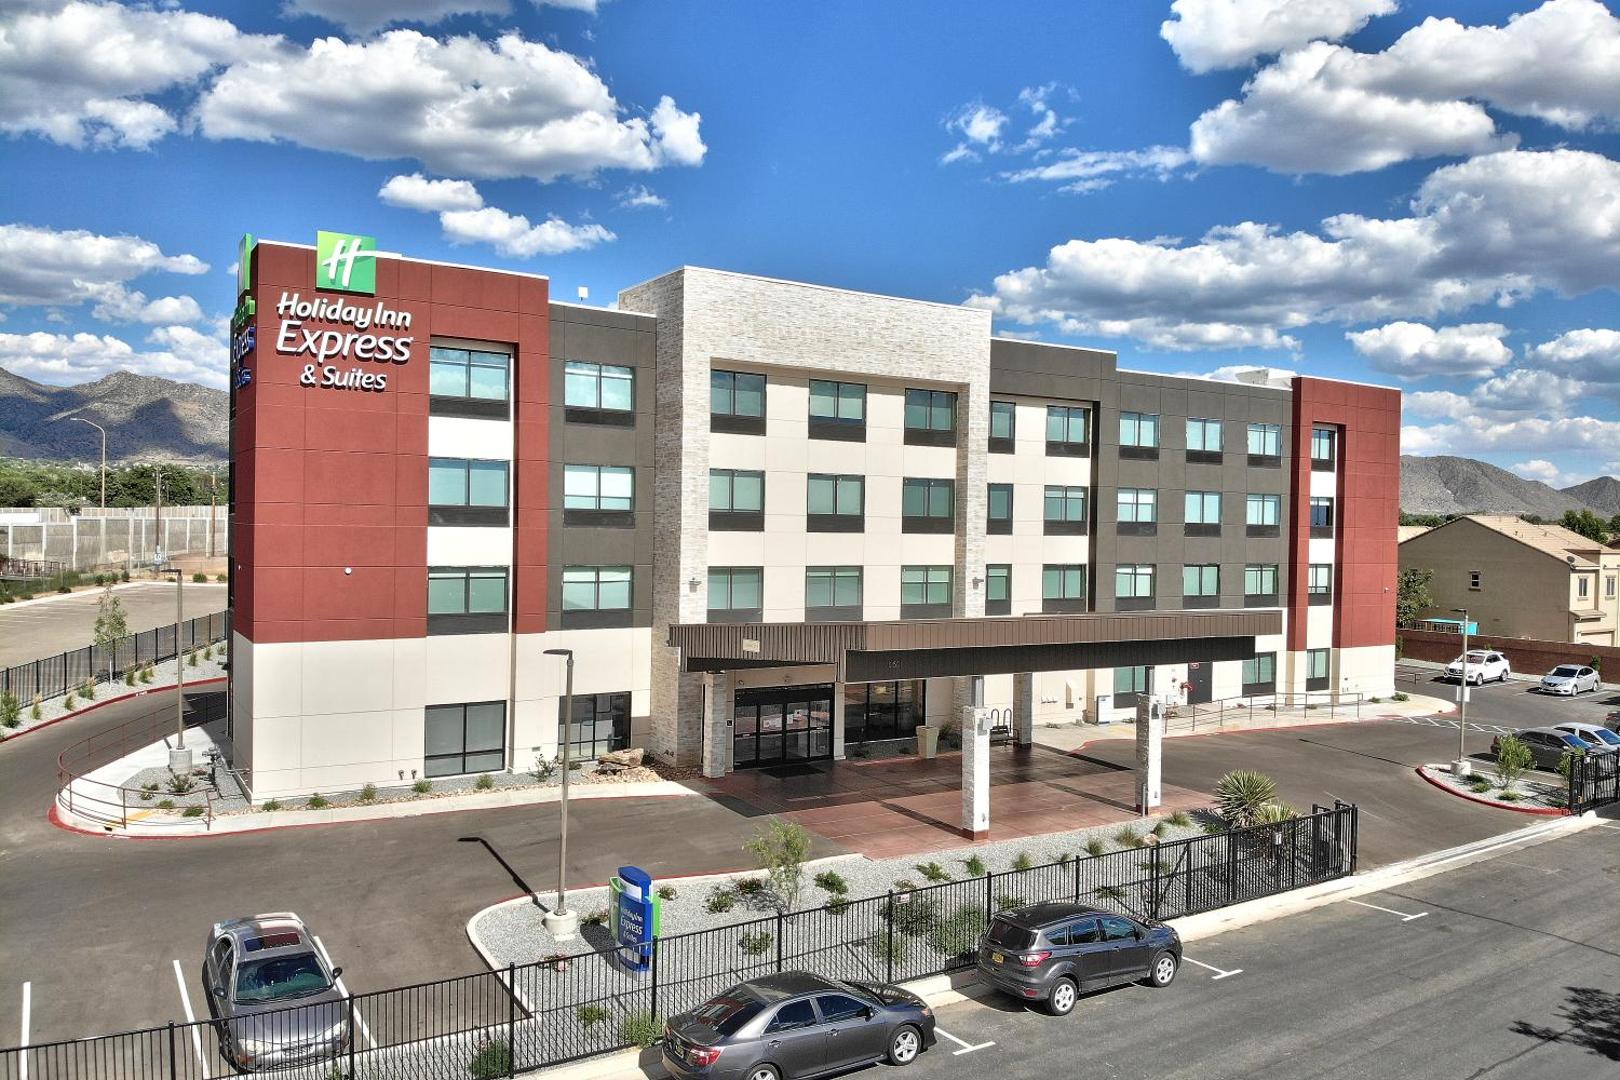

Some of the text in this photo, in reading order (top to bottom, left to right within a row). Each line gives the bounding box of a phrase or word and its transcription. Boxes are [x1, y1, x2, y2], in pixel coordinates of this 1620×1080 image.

[277, 291, 373, 329] Holiday
[374, 301, 412, 328] Inn
[276, 319, 412, 363] Express
[300, 364, 388, 390] & Suites
